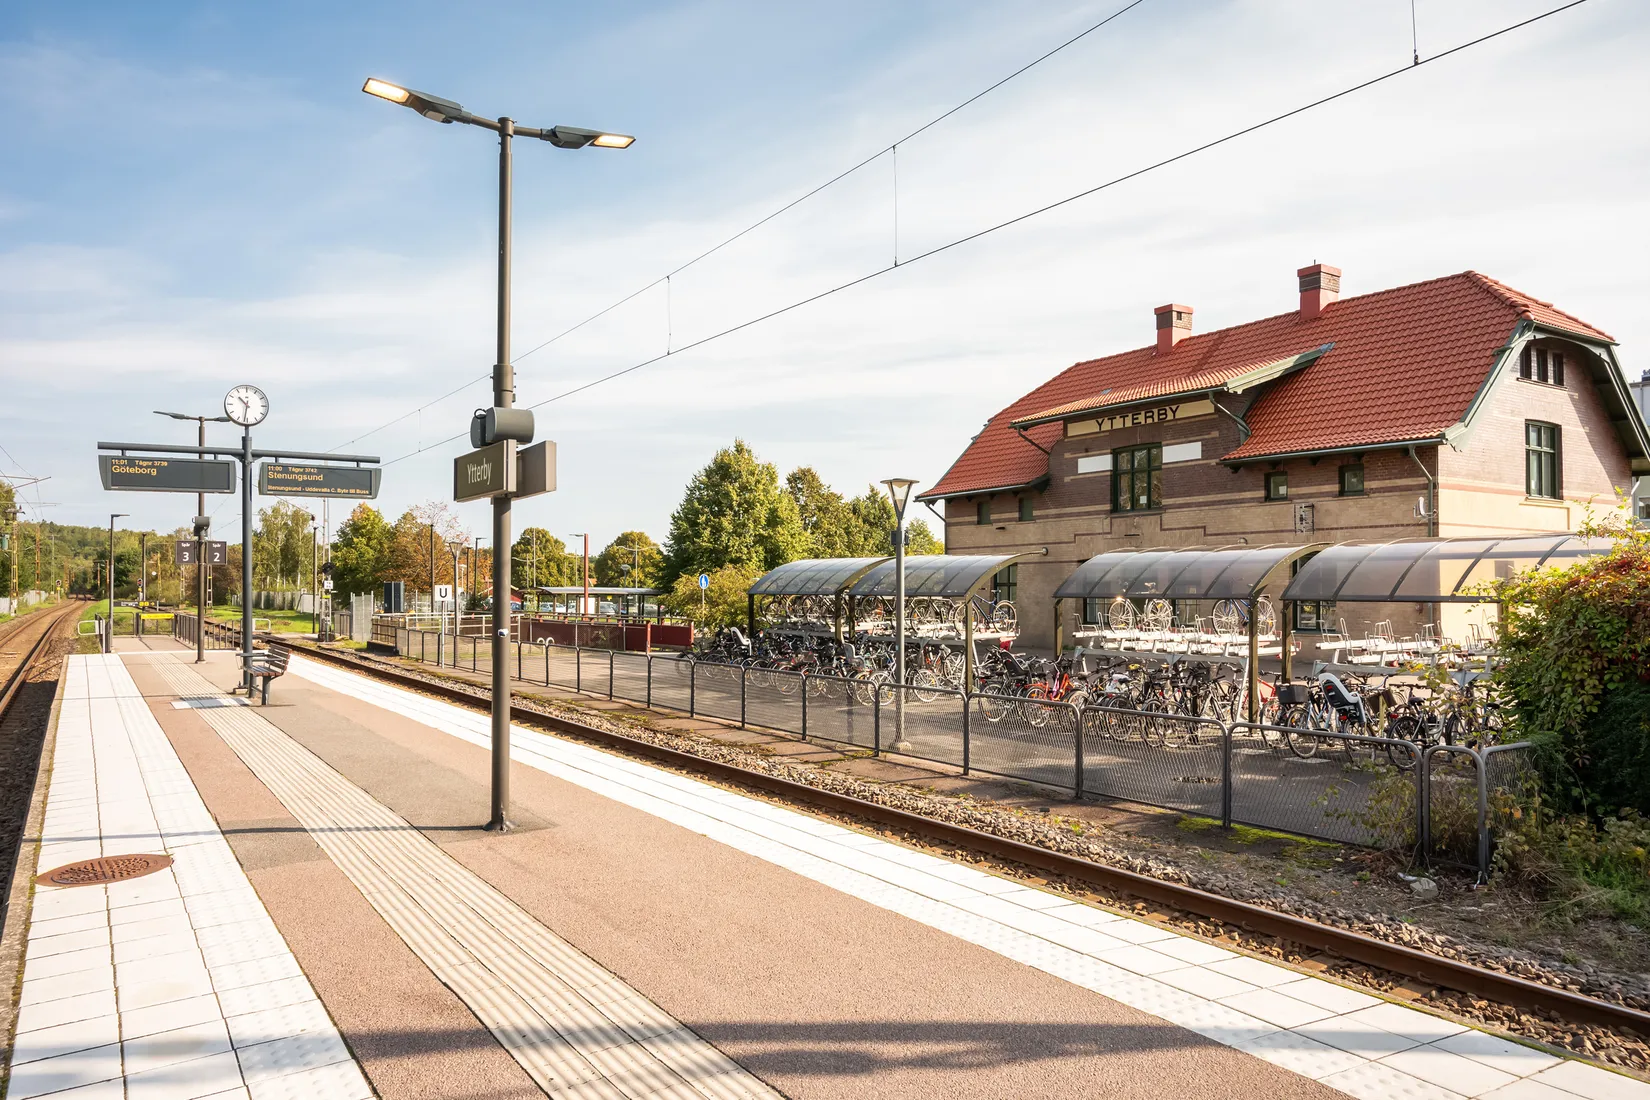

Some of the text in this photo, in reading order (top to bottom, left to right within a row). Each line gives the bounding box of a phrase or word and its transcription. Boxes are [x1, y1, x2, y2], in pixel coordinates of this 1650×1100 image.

[1096, 405, 1180, 431] YTTERBY
[112, 465, 157, 475] Göteborg
[467, 458, 492, 485] Ytterby
[268, 472, 323, 481] Stenungsund
[182, 551, 190, 562] 3
[213, 552, 221, 562] 2
[439, 587, 448, 598] U
